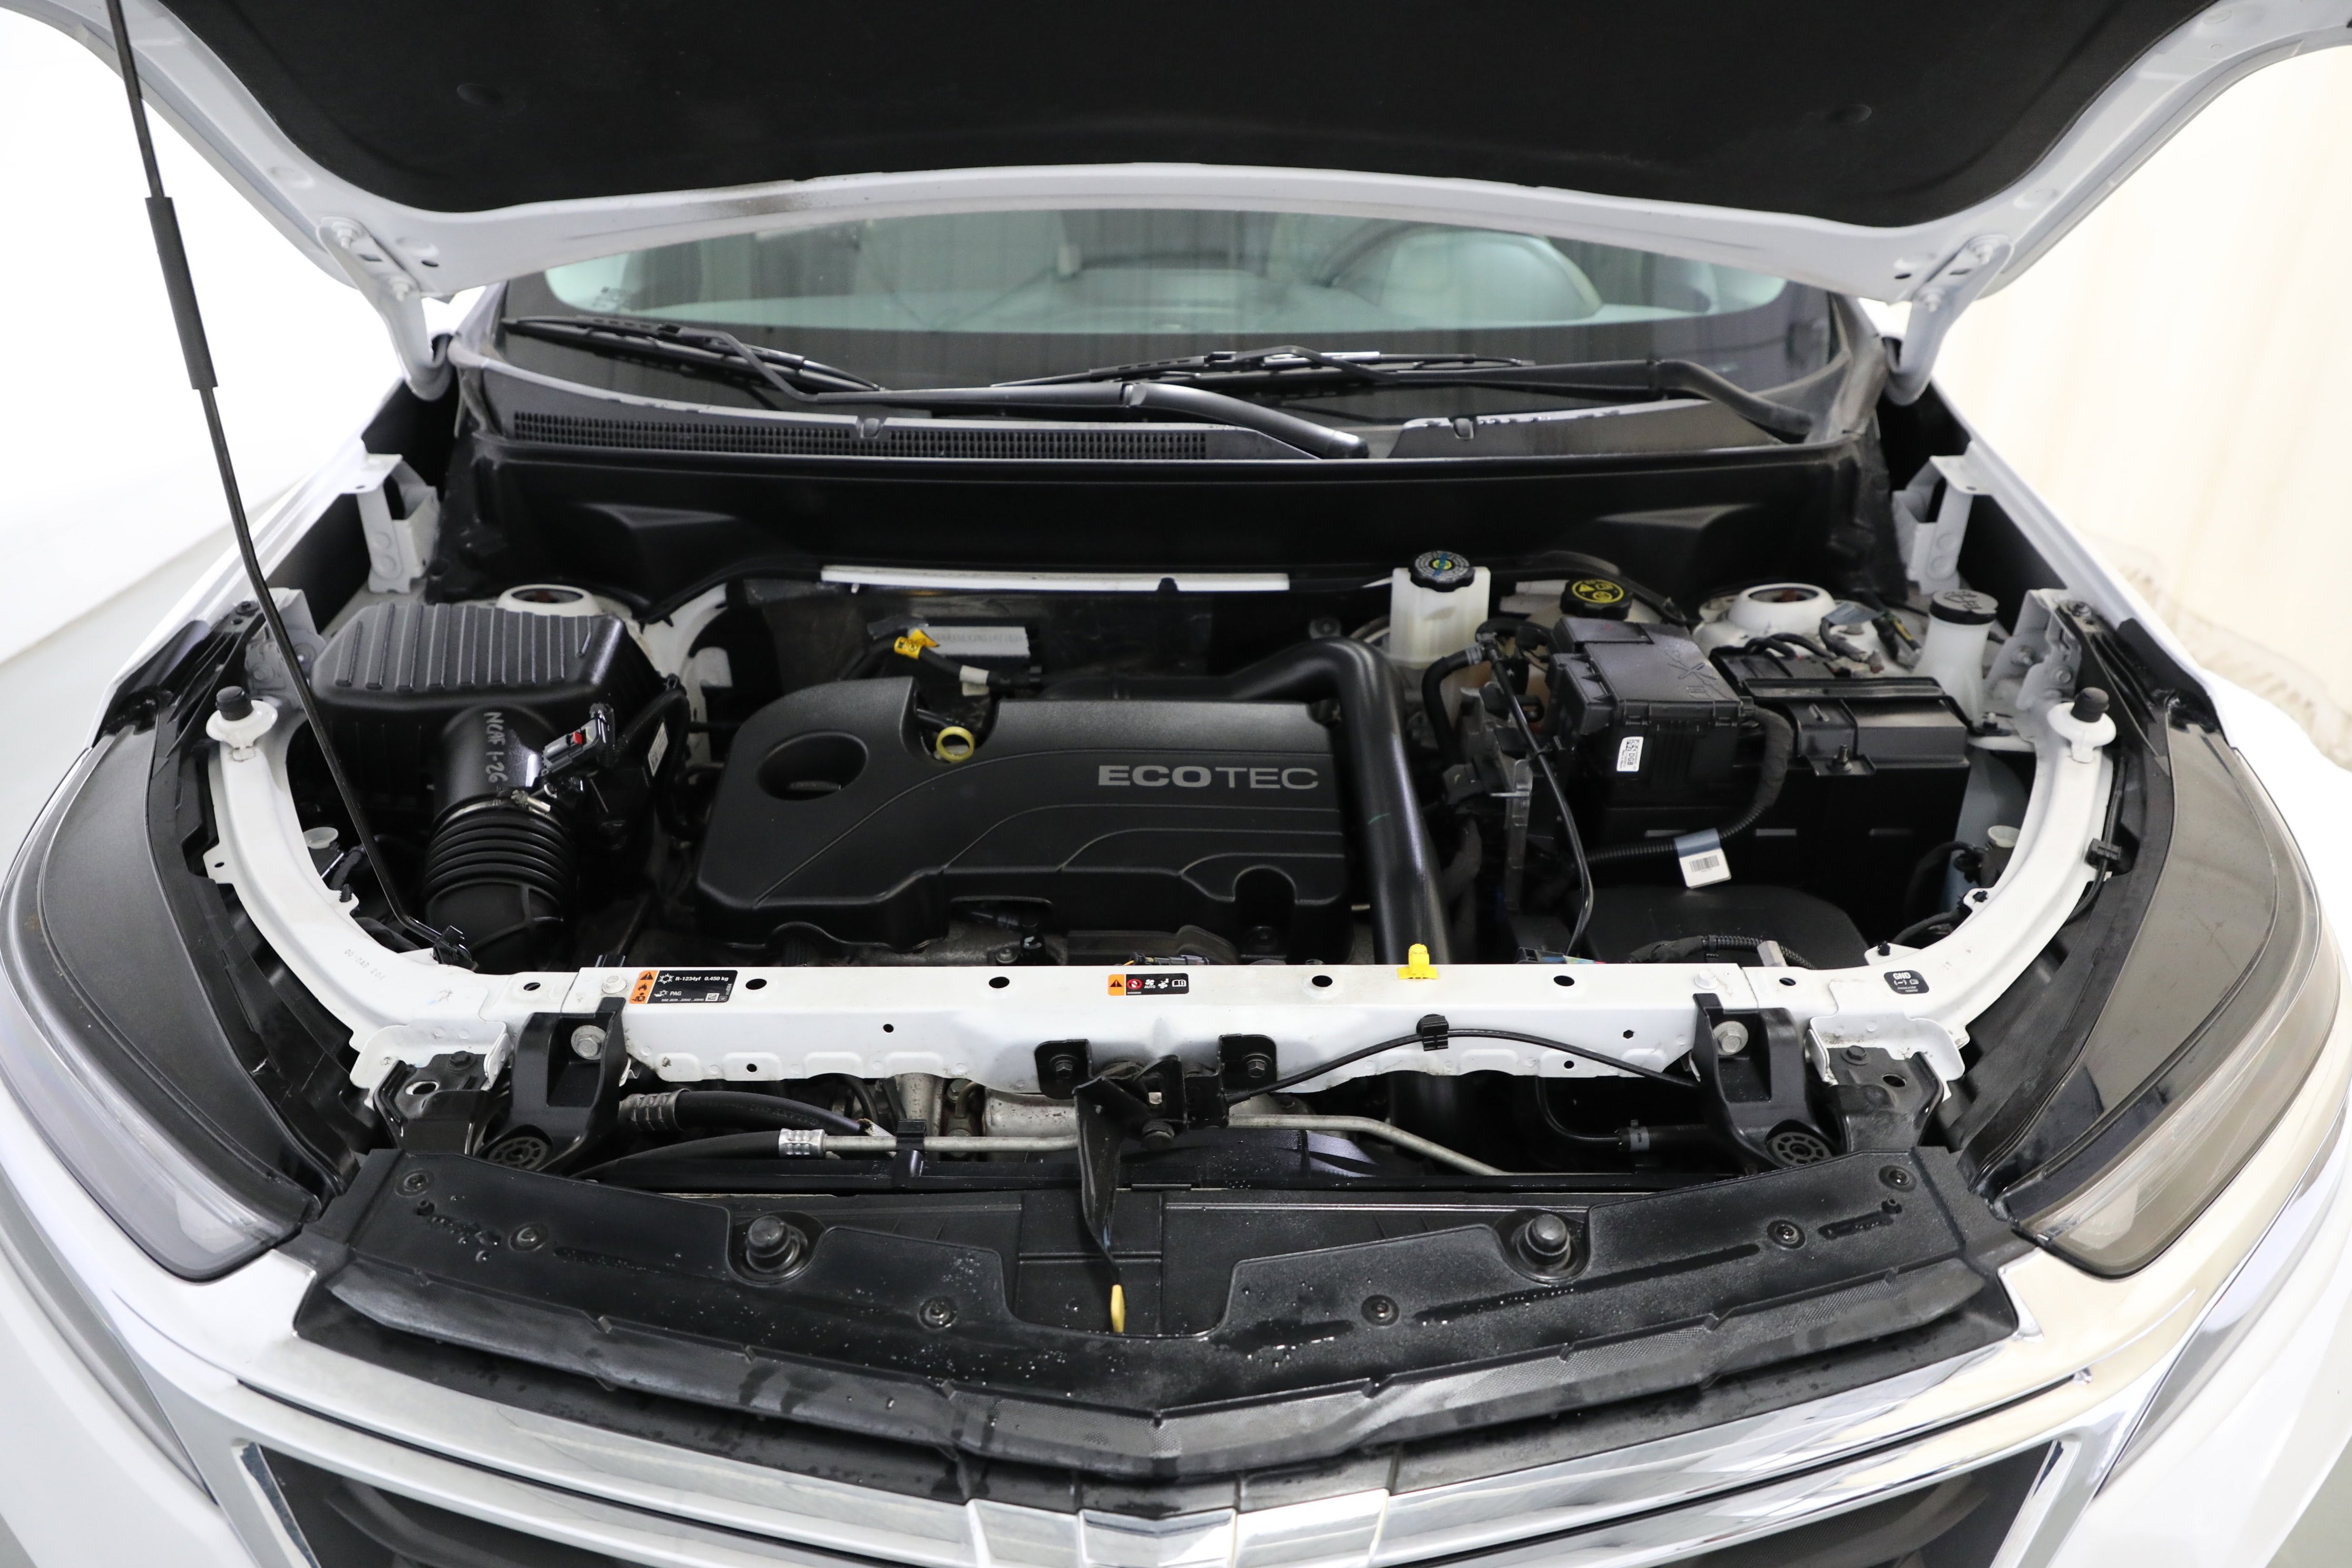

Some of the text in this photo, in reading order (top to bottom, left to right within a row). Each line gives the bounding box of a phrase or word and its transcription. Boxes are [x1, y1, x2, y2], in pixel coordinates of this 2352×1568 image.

[485, 751, 508, 783] 1-26
[1098, 765, 1319, 789] ECOTEC
[1893, 972, 1912, 980] GND
